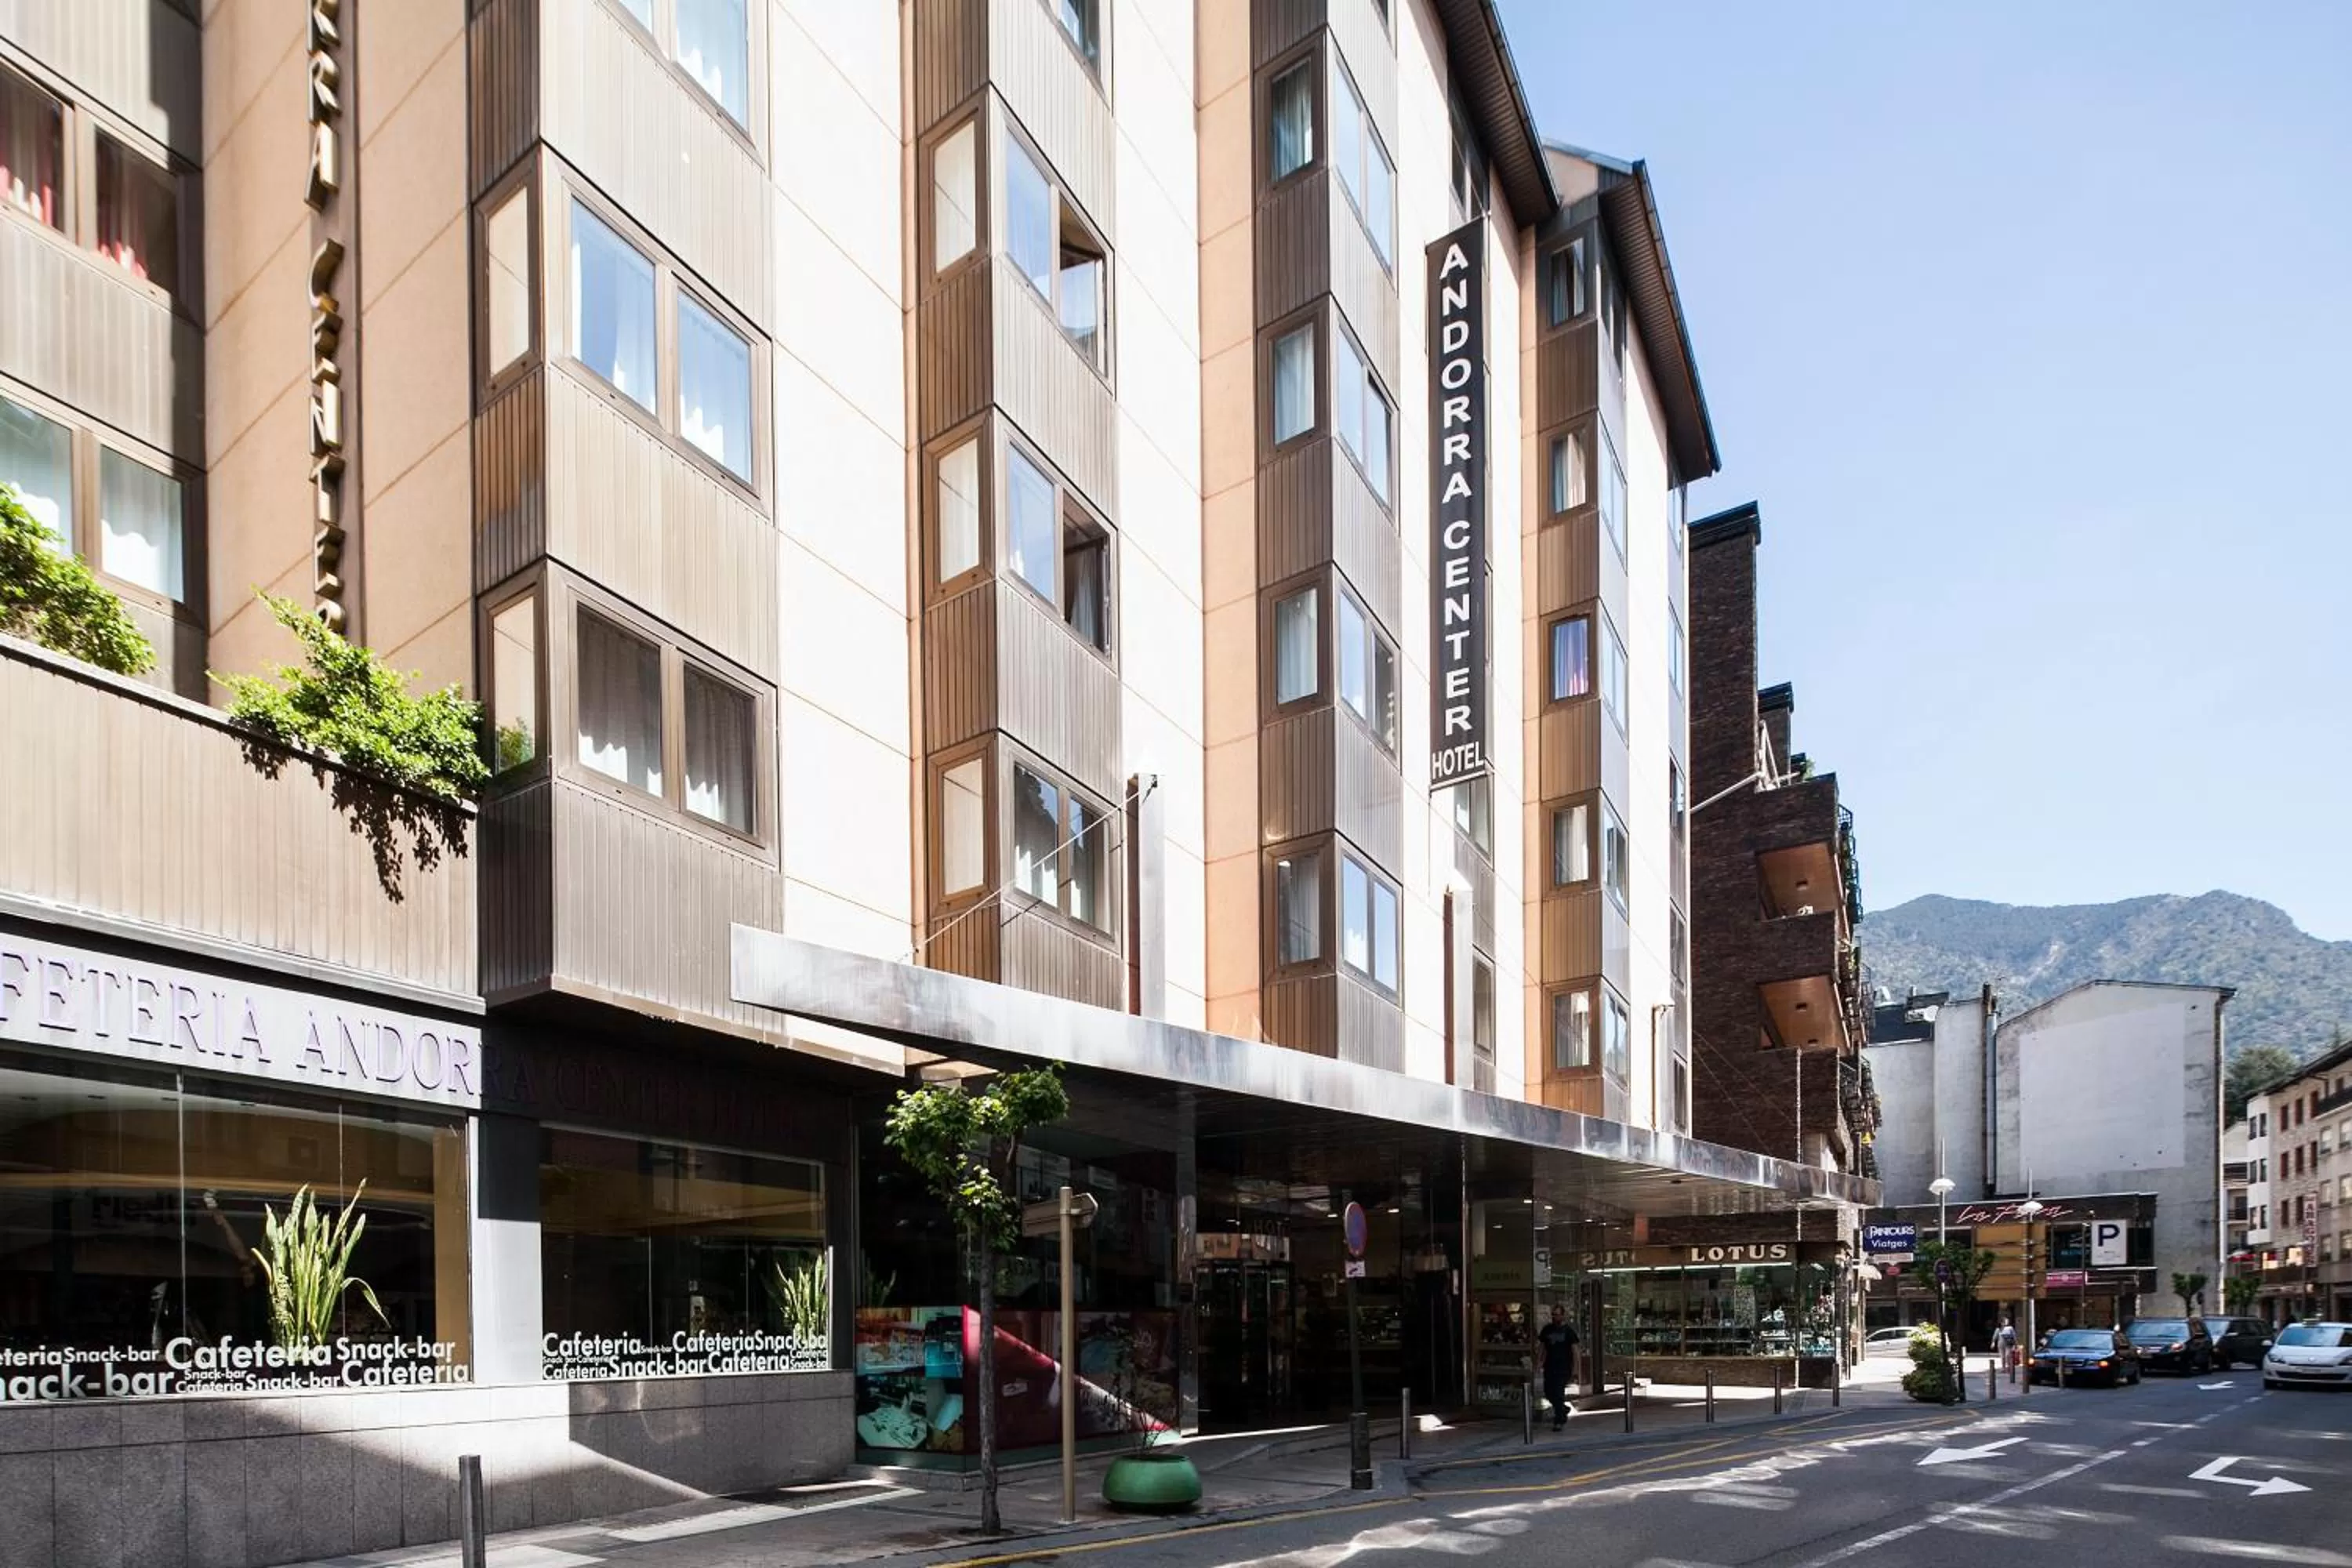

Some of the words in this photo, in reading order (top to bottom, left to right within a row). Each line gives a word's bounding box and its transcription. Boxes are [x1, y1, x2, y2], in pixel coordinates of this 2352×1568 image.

[1439, 242, 1472, 503] ANDORRA
[1443, 520, 1473, 737] CENTER
[1432, 741, 1484, 779] HOTEL
[0, 946, 272, 1063] FETERIA
[1690, 1243, 1788, 1262] LOTUS
[1871, 1240, 1908, 1250] Viatges
[2097, 1223, 2121, 1247] P
[0, 1345, 62, 1366] teria
[64, 1345, 159, 1363] Snack-bar
[165, 1335, 332, 1370] Cafeteria
[336, 1335, 456, 1361] Snack-bar
[543, 1330, 641, 1357] Cafeteria
[673, 1330, 754, 1352] Cafeteria
[0, 1362, 174, 1400] ack-bar
[184, 1367, 247, 1381] Snack-bar
[175, 1379, 244, 1393] Cafeteria
[245, 1372, 341, 1392] Snack-bar
[341, 1356, 470, 1387] Cafeteria
[543, 1363, 608, 1379] Cafeteria
[609, 1352, 707, 1377] Snack-bar
[707, 1350, 790, 1373] Cafeteria
